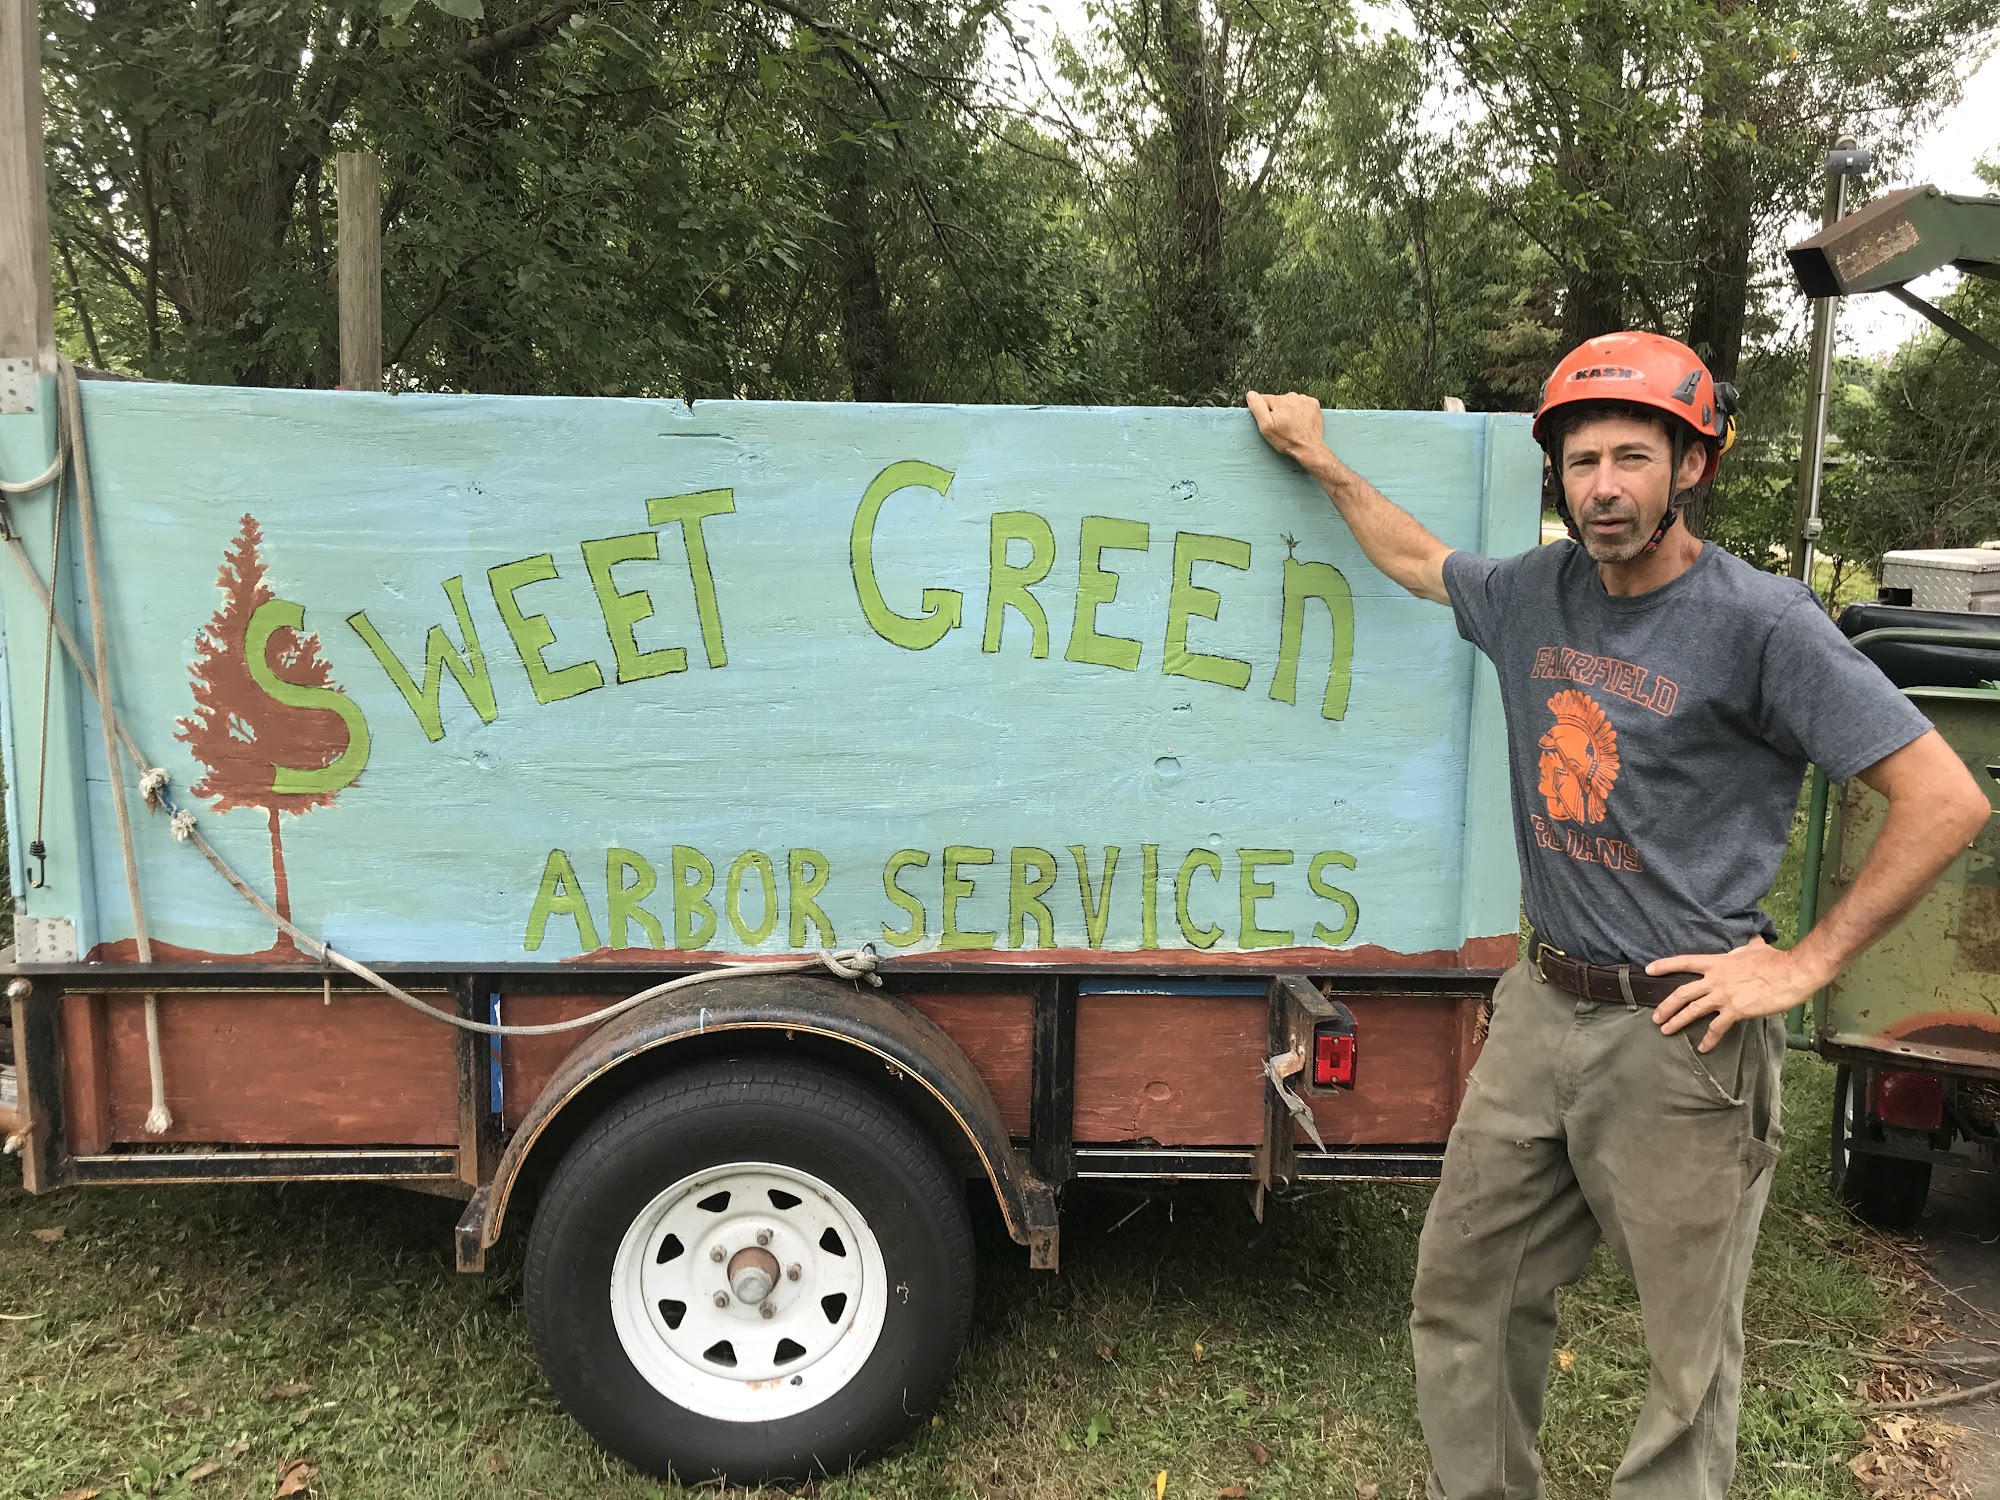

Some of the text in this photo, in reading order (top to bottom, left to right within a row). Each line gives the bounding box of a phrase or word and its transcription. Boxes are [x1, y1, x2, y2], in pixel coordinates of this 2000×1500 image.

[1575, 366, 1633, 381] KASK
[243, 487, 737, 795] SWEET
[1530, 645, 1679, 717] FAIRFIELD
[1529, 813, 1643, 873] ROJANS
[523, 844, 1361, 952] ARBOR SERVICES
